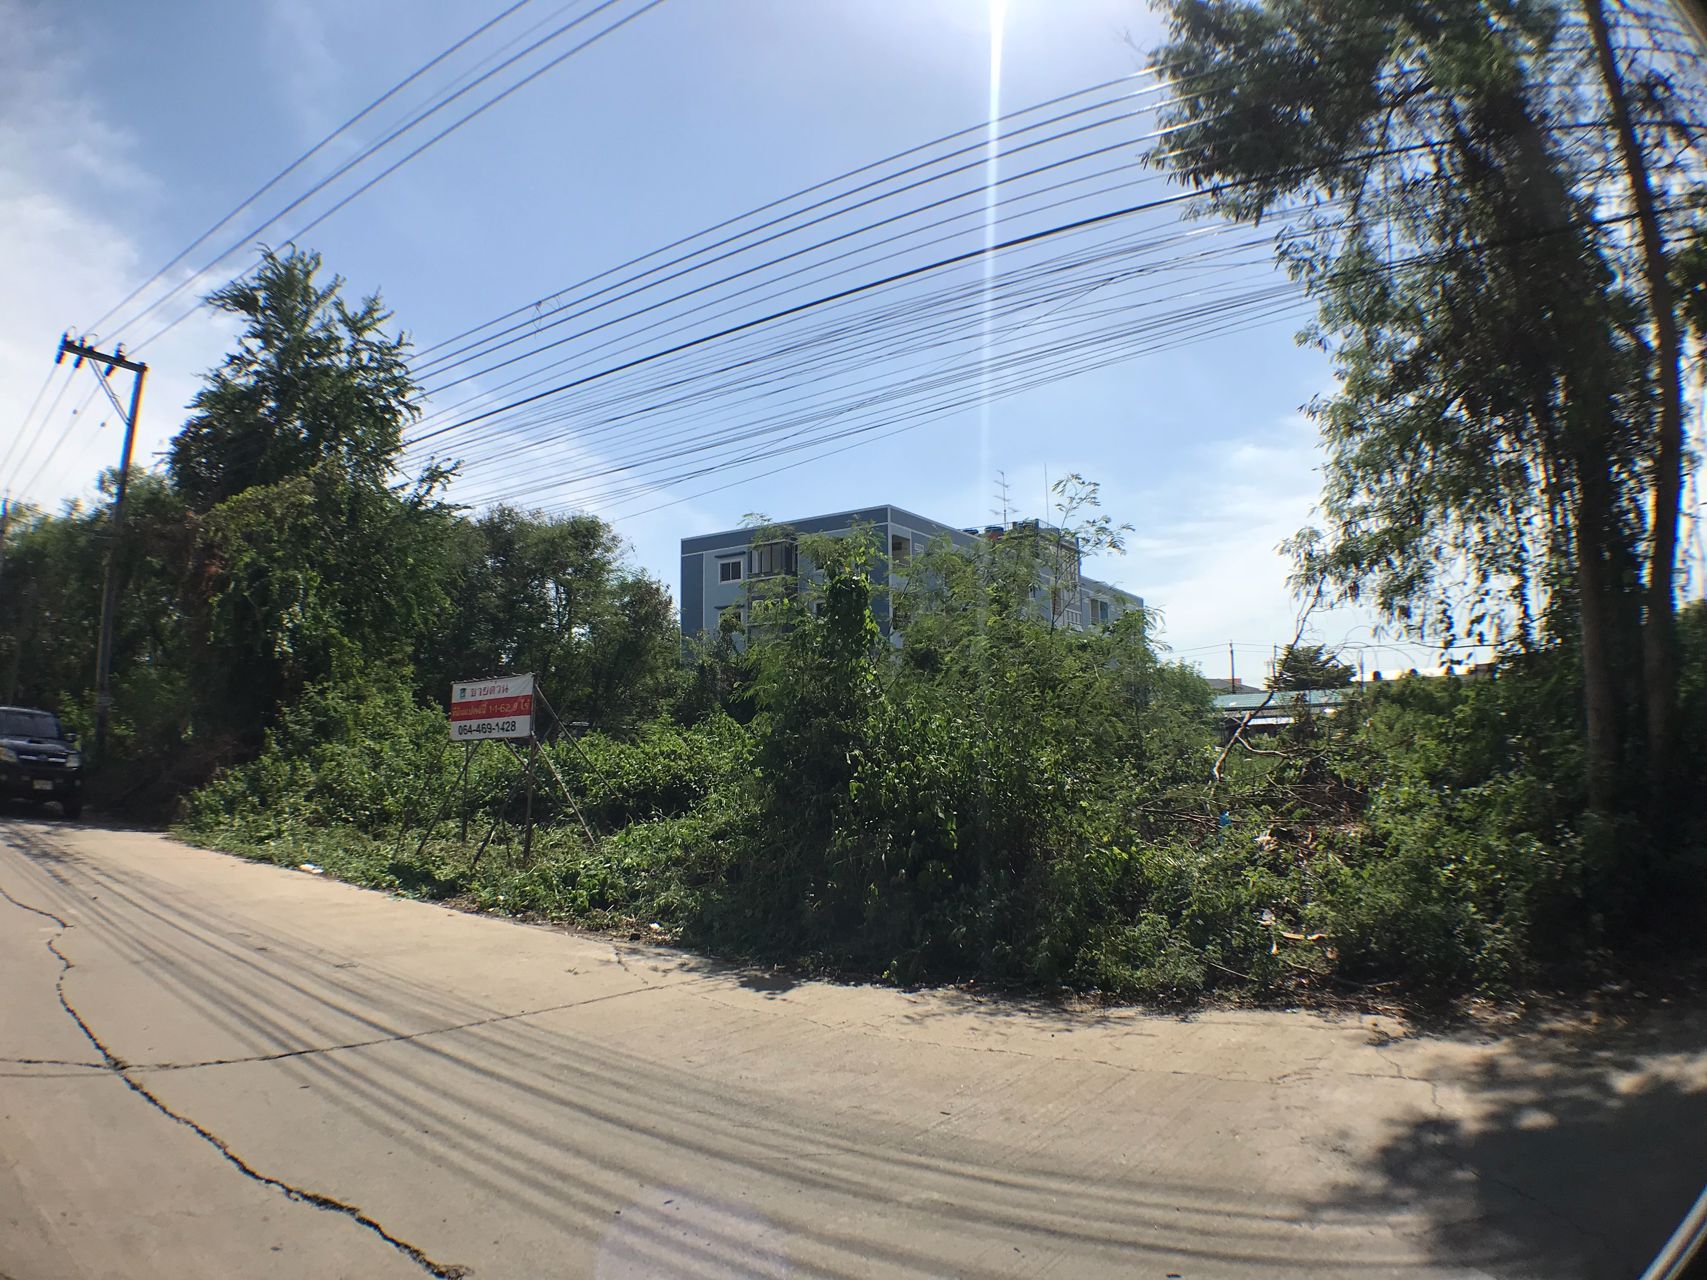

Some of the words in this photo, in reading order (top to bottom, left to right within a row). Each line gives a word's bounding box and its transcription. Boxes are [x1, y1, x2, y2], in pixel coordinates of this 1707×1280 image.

[471, 681, 509, 697] ขายด่วน
[458, 721, 517, 735] 064-469-1428
